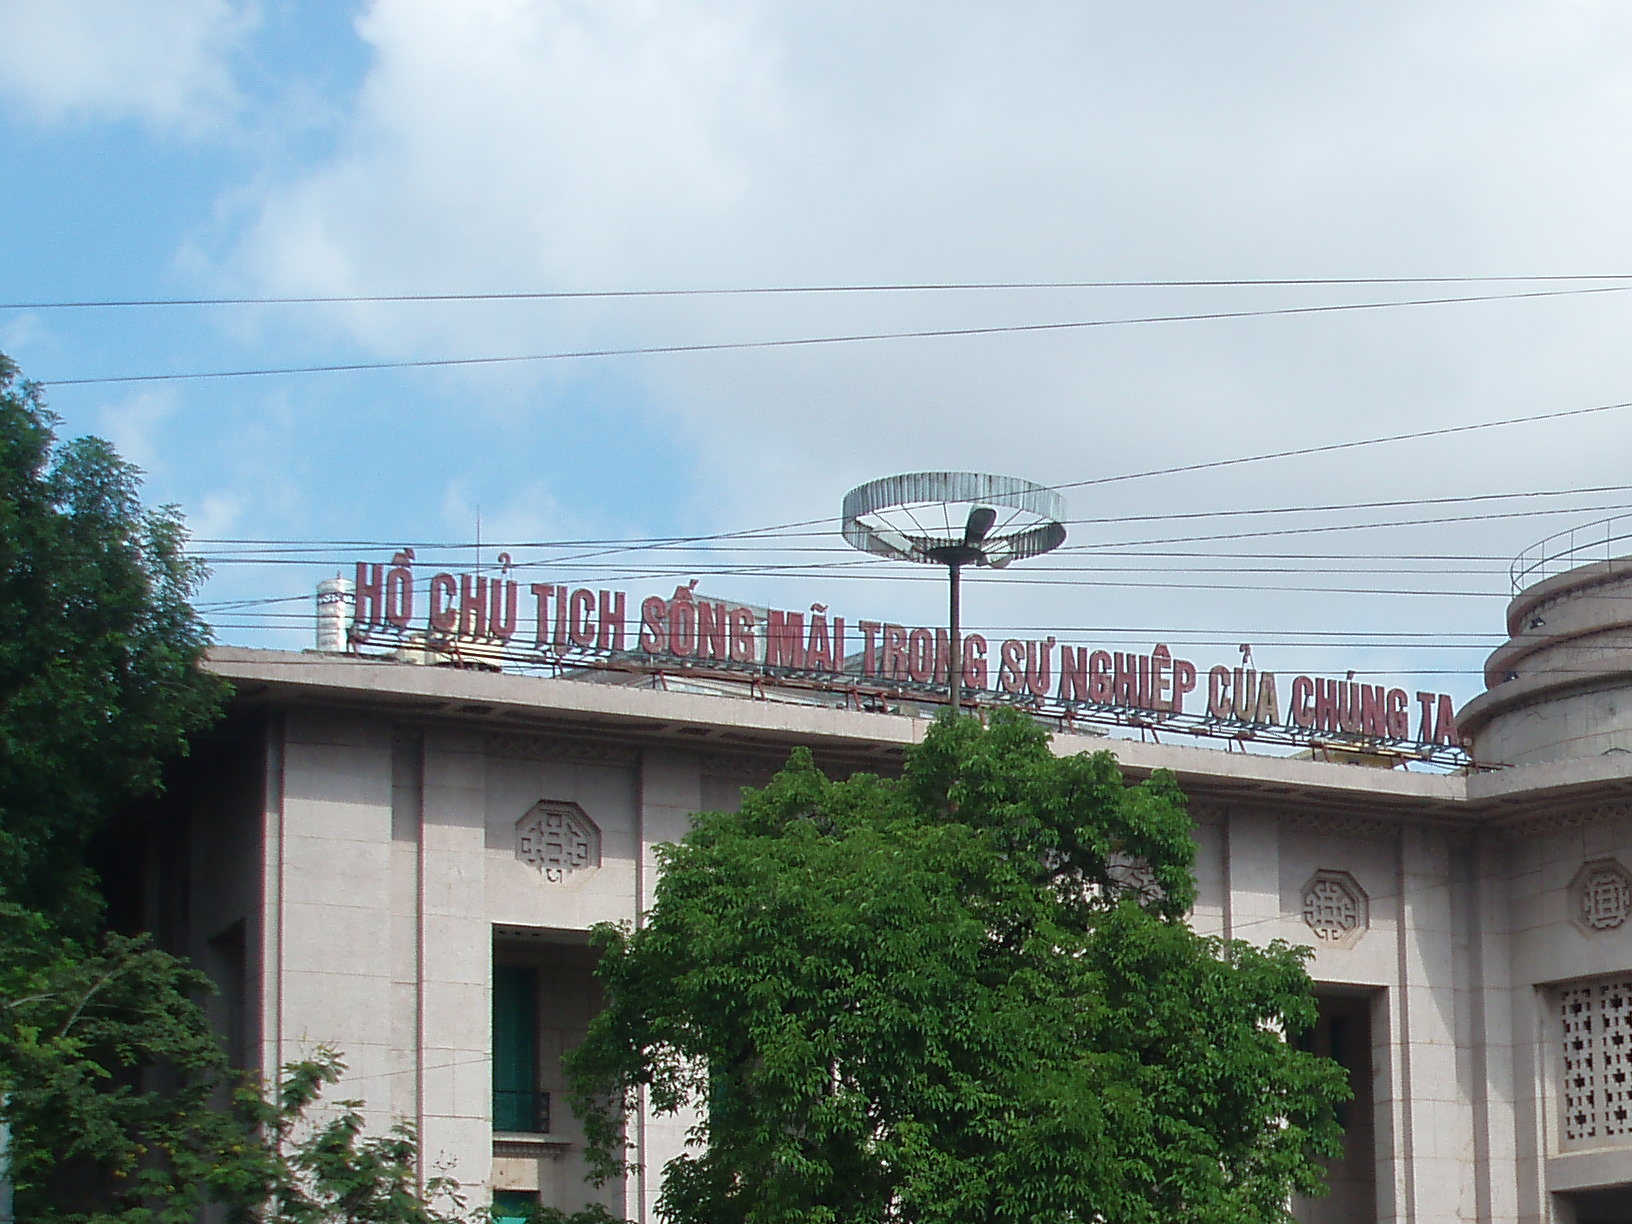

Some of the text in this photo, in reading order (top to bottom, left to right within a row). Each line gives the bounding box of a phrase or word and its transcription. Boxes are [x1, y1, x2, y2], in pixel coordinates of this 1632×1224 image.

[355, 548, 1459, 746] HỒ CHỦ TỊCH SỐNG MÃI TRONG SỰ NGHIỆP CỦA CHÚNG TA
